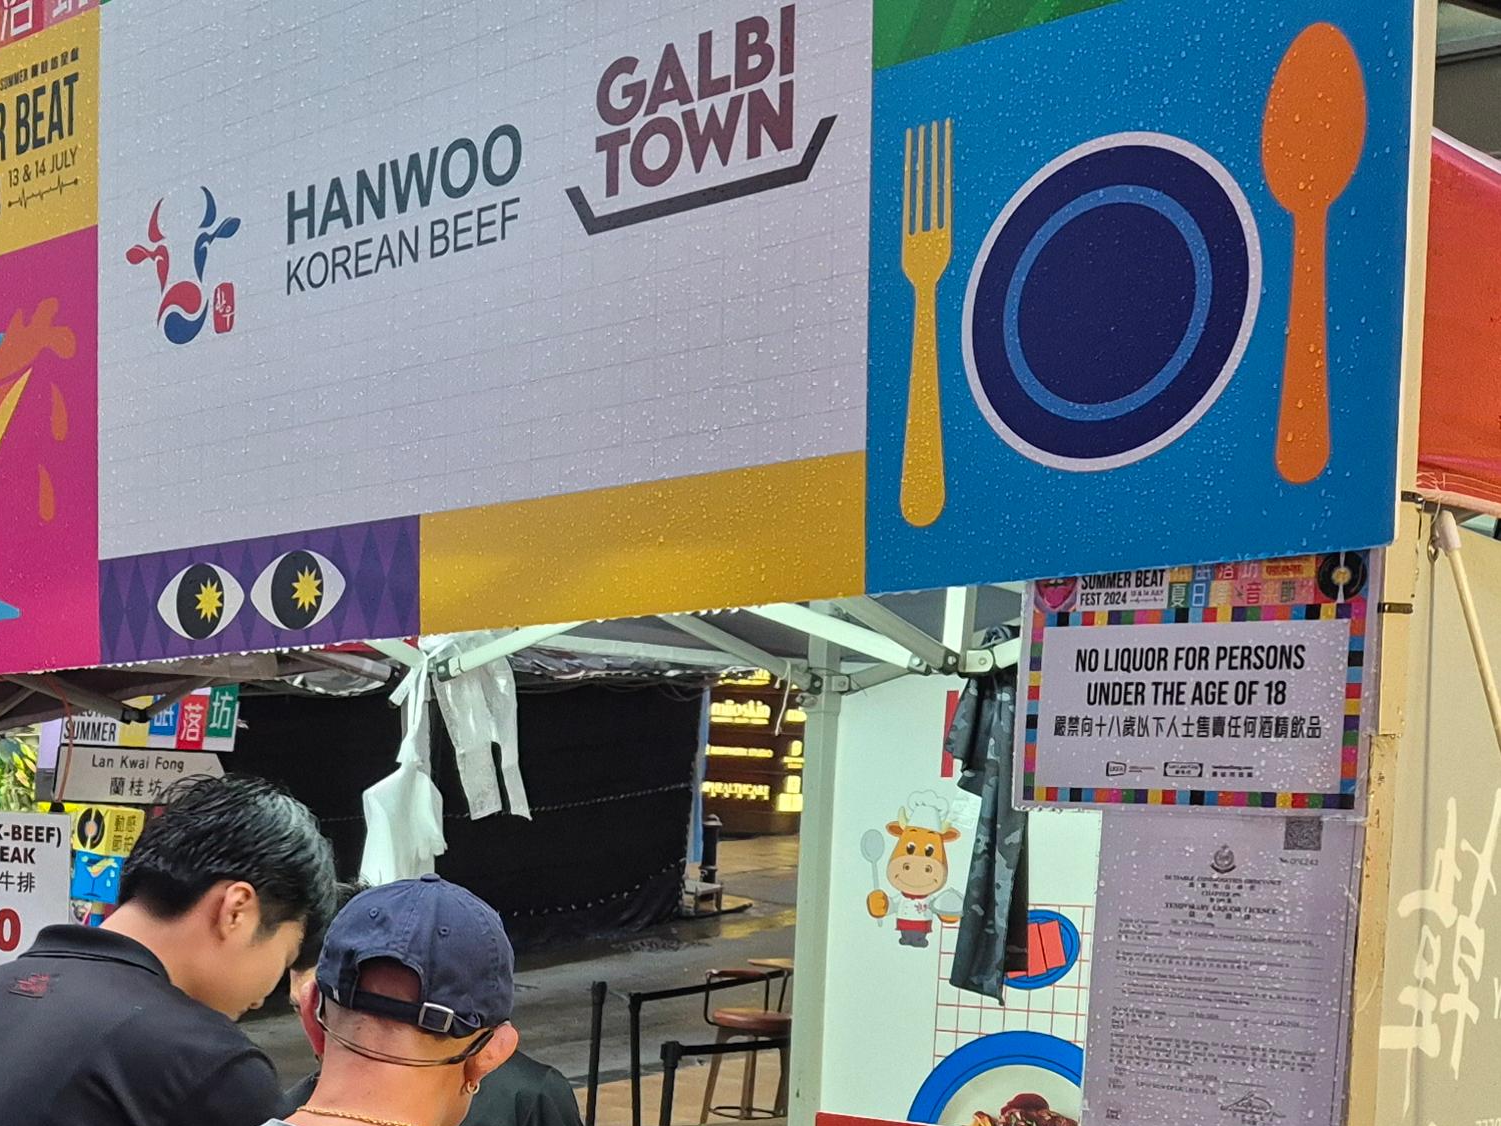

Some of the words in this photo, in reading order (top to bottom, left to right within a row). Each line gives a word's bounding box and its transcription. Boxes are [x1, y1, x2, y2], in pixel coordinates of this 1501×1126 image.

[598, 3, 795, 126] GALBI
[0, 68, 29, 92] SUMMER
[15, 72, 80, 155] BEAT
[596, 80, 794, 198] TOWN
[8, 169, 19, 188] 13
[22, 164, 31, 183] &
[35, 158, 47, 176] 14
[50, 146, 79, 174] JULY
[286, 123, 522, 246] HANWOO
[286, 231, 420, 296] KOREAN
[429, 197, 521, 260] BEEF
[1081, 571, 1132, 591] SUMMER
[1134, 568, 1167, 588] BEAT
[1080, 591, 1102, 606] FEST
[1104, 591, 1127, 606] 2024
[1075, 648, 1099, 673] NO
[1103, 647, 1169, 674] LIQUOR
[1173, 647, 1210, 672] FOR
[1215, 644, 1306, 671] PERSONS
[1086, 681, 1145, 707] UNDER
[1153, 681, 1188, 706] THE
[1191, 680, 1229, 706] AGE
[1234, 680, 1259, 706] OF
[1264, 681, 1287, 706] 18
[64, 719, 117, 742] SUMMER
[1054, 715, 1322, 740] 嚴禁向十八歲以下人士售賣任何酒精飲品
[92, 754, 114, 768] Lan
[120, 755, 149, 770] Kwai
[155, 757, 185, 772] Fong
[109, 776, 163, 797] 蘭桂坊
